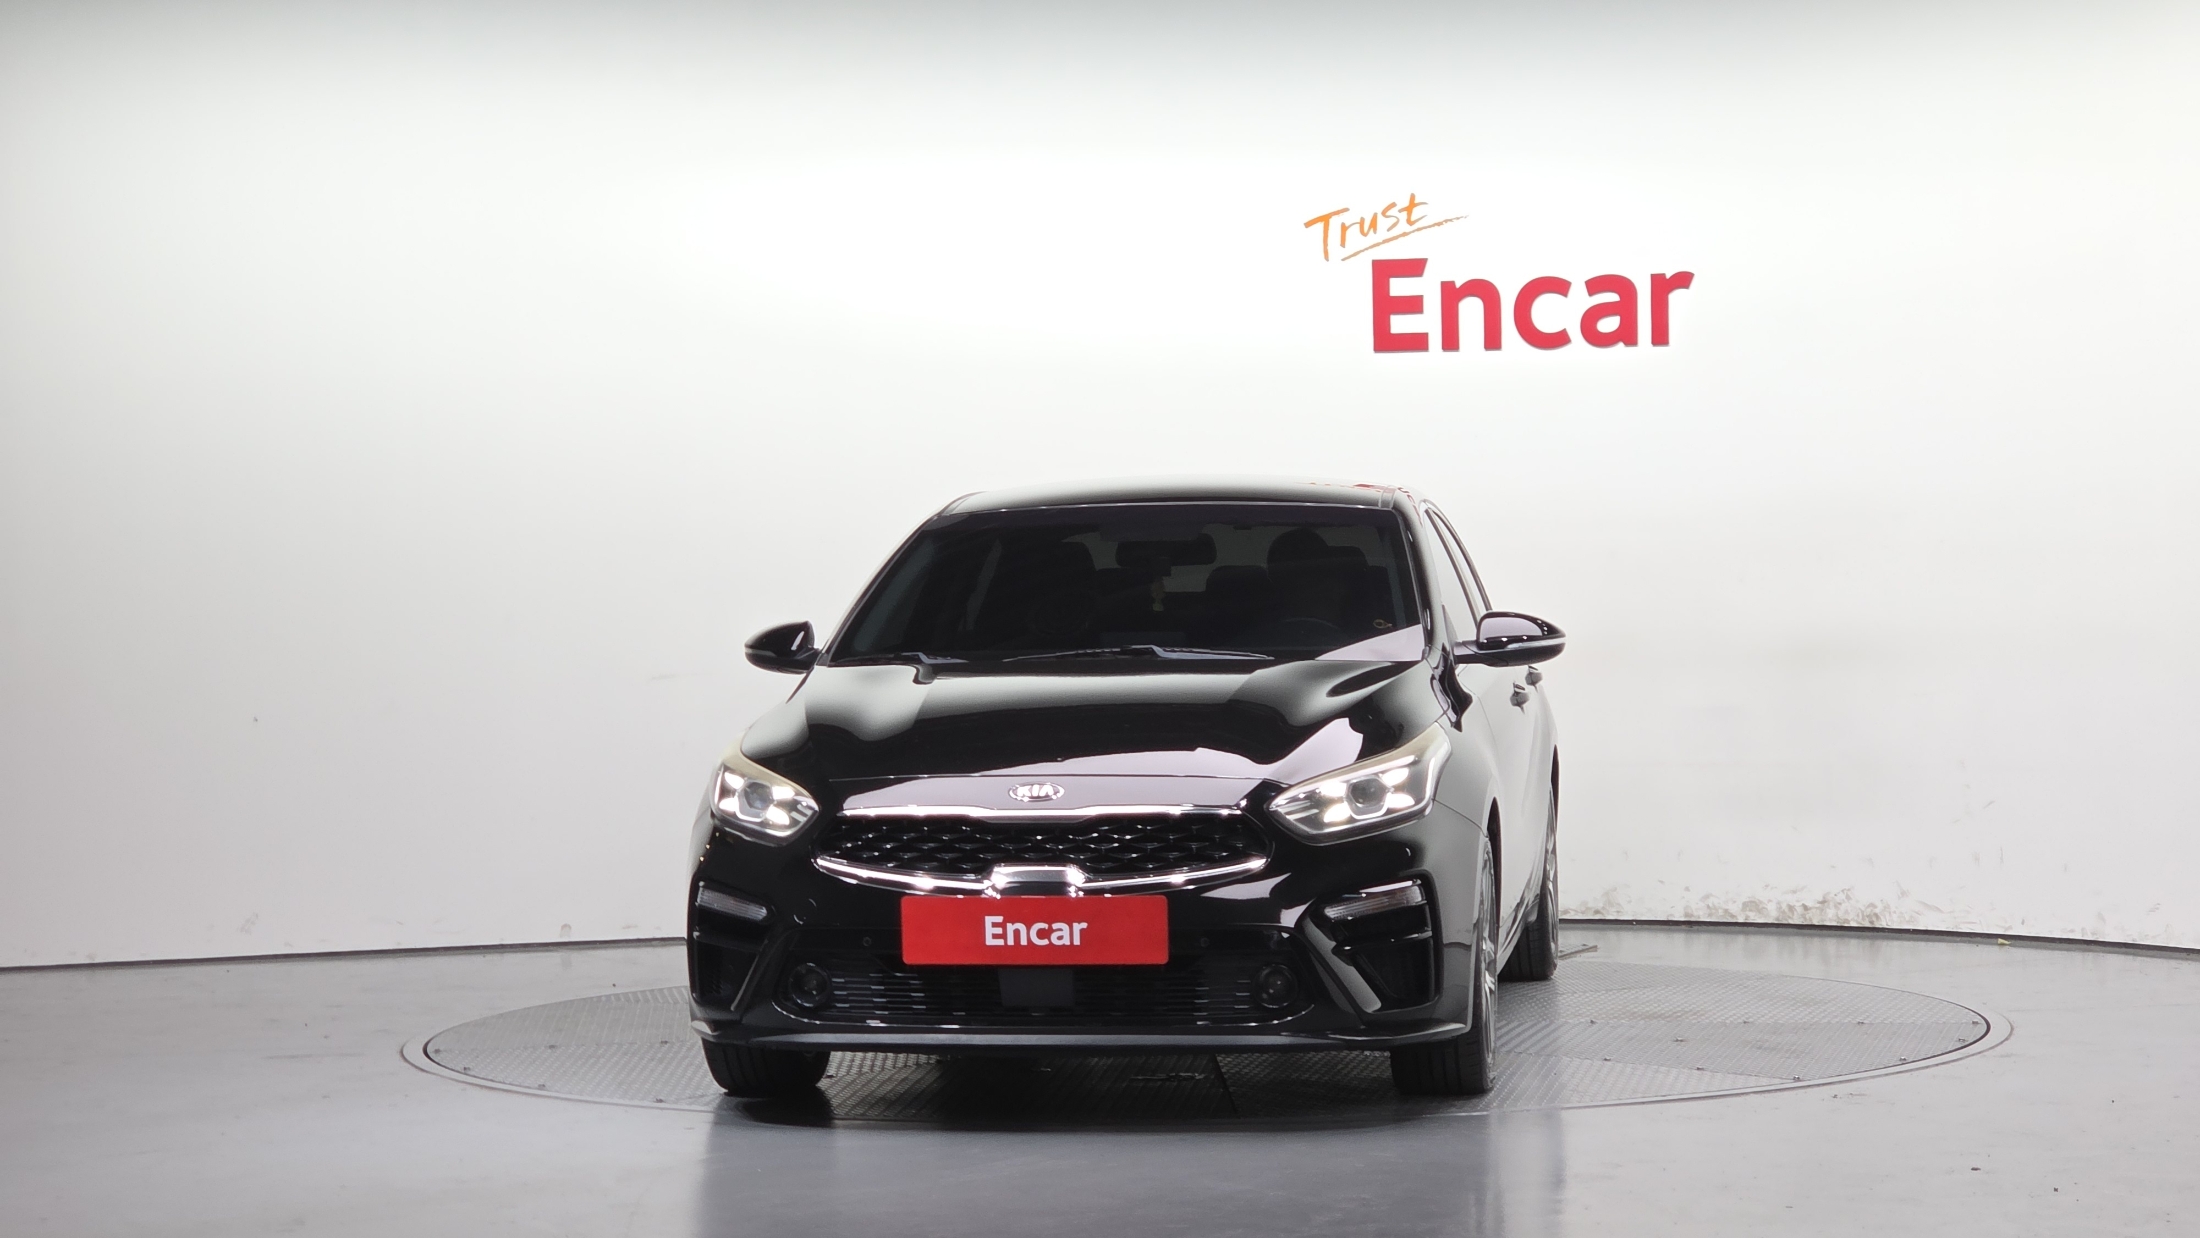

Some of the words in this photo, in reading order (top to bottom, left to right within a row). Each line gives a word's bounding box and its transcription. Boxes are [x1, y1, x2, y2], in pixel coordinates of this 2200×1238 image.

[1304, 193, 1428, 261] Trust
[1372, 258, 1694, 353] Encar
[1017, 784, 1055, 797] KIA
[984, 915, 1088, 946] Encar
